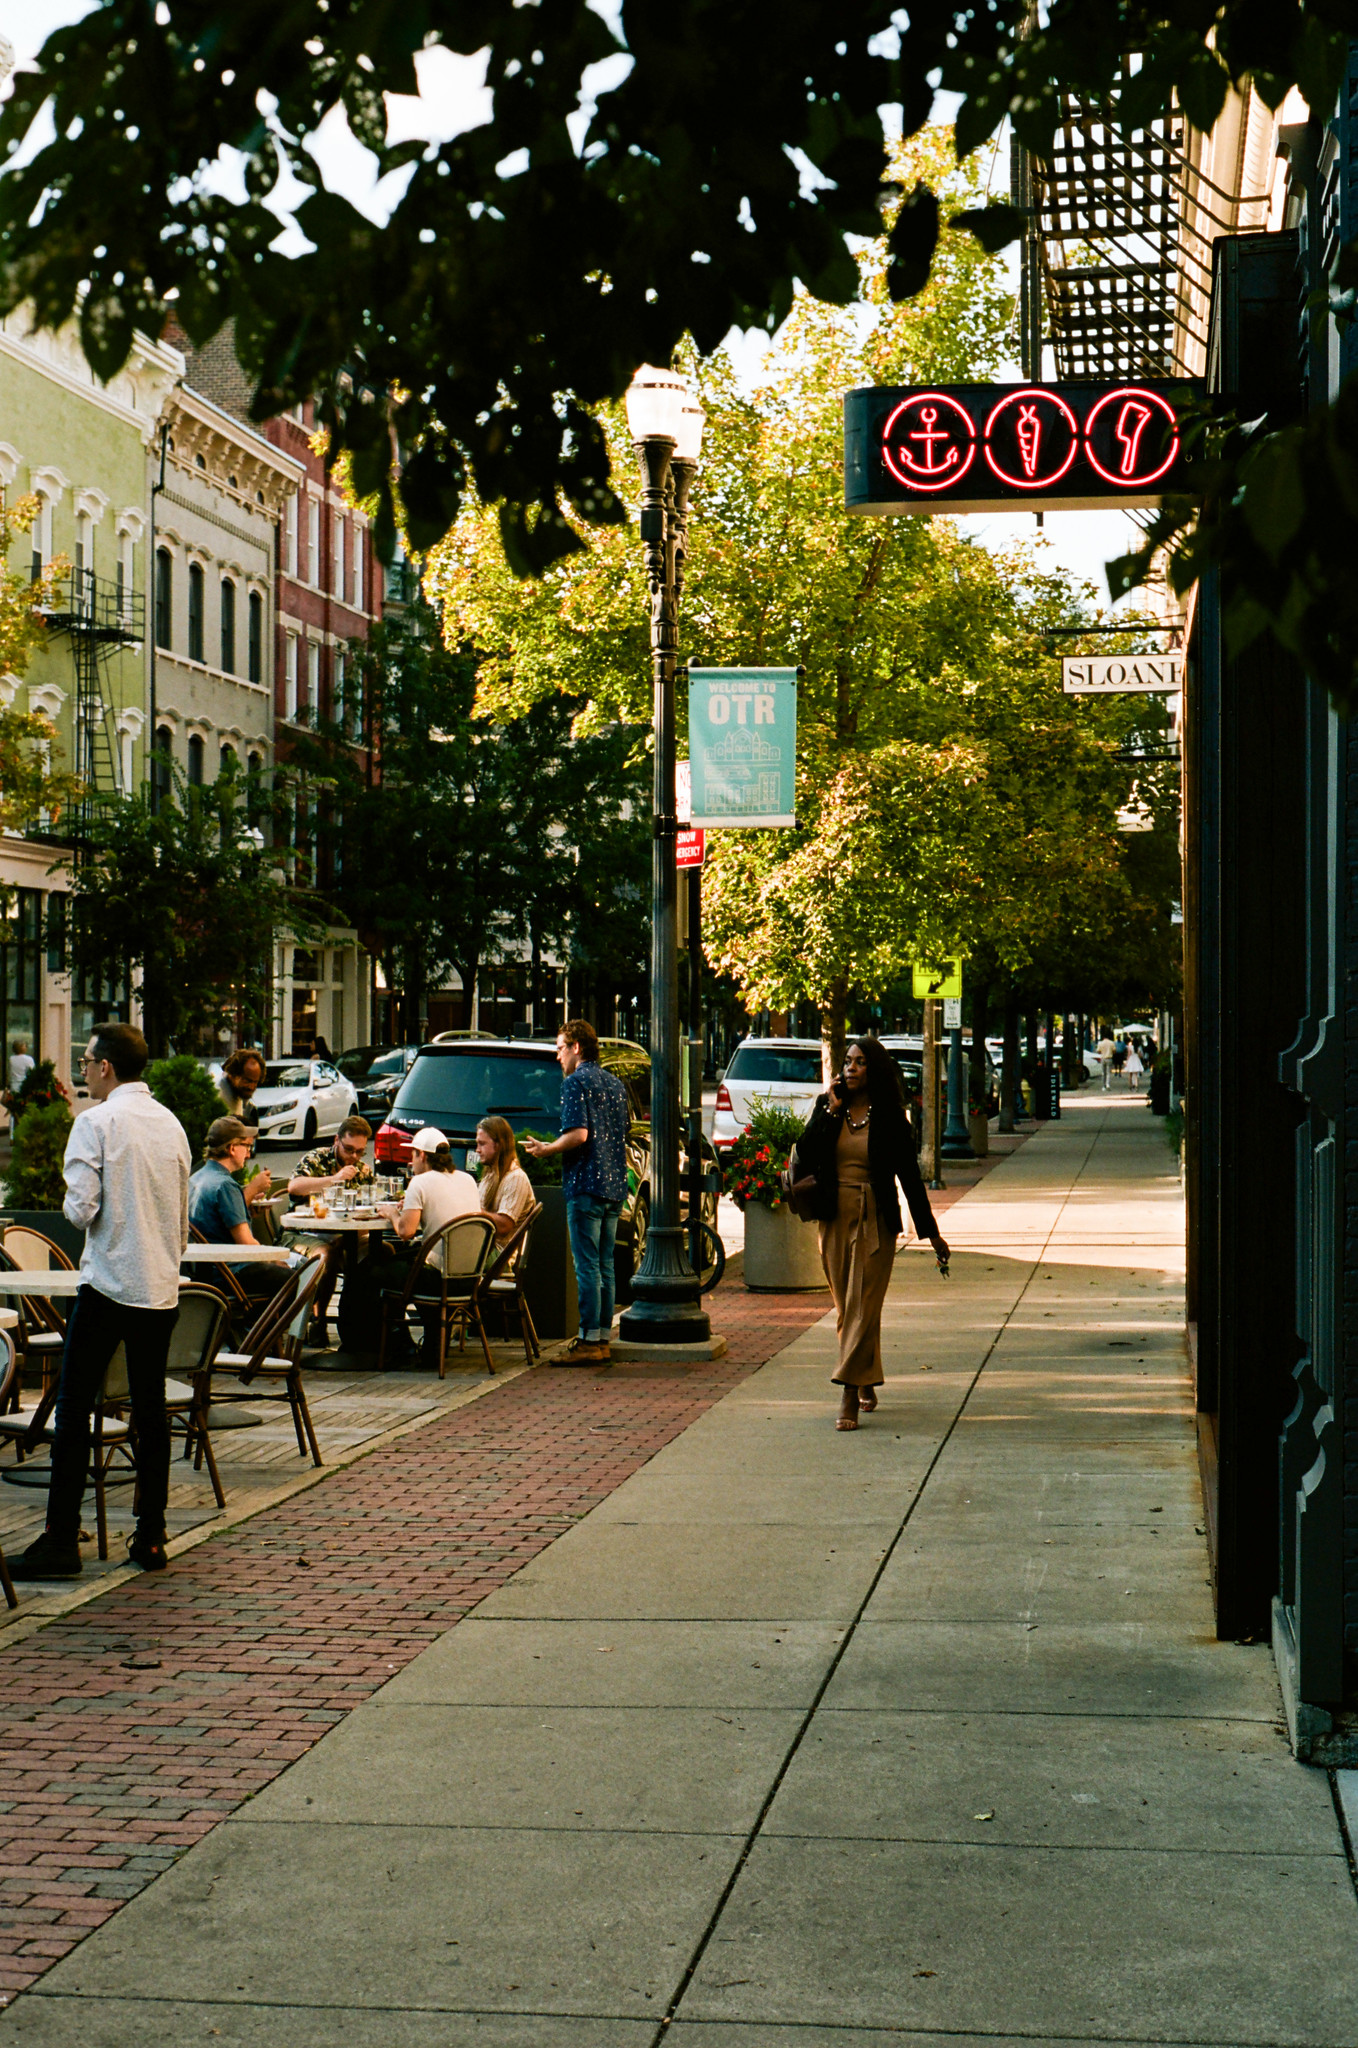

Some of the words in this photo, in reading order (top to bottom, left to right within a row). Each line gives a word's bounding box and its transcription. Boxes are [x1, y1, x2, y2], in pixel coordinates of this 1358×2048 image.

[709, 682, 760, 693] WELCOME
[762, 682, 776, 693] TO
[708, 694, 775, 725] OTR
[677, 831, 696, 844] SNOW
